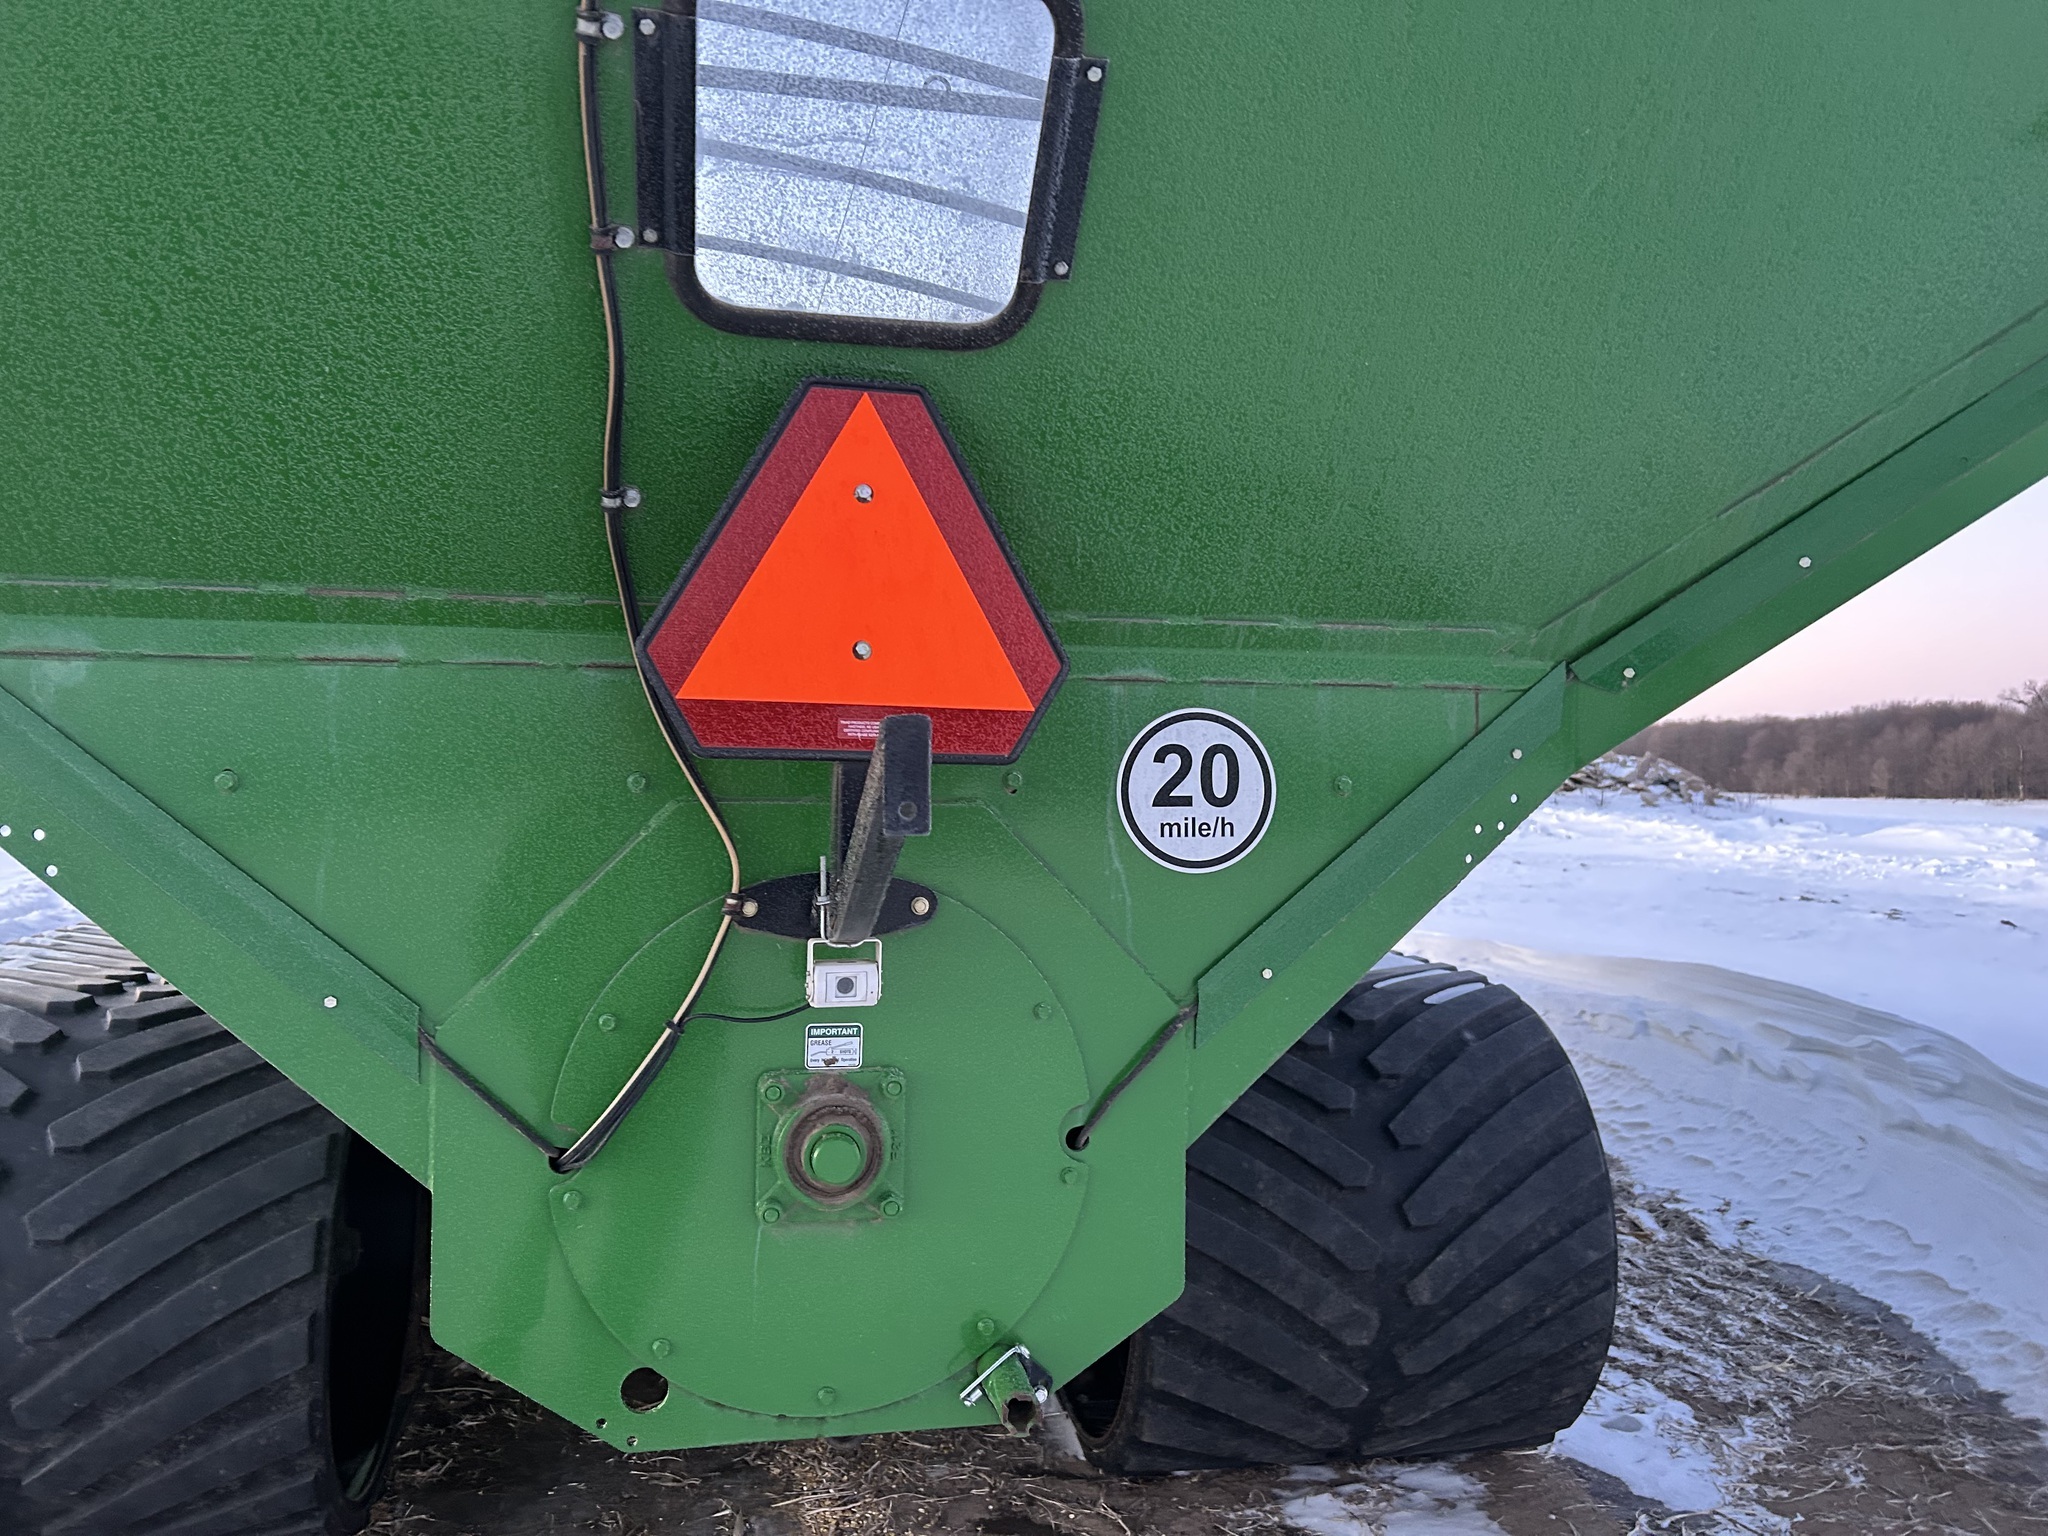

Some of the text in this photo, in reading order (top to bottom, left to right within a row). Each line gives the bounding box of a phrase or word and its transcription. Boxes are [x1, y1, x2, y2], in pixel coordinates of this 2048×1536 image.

[1152, 743, 1239, 807] 20
[1160, 816, 1235, 838] mile/h
[810, 1027, 858, 1036] IMPORTANT
